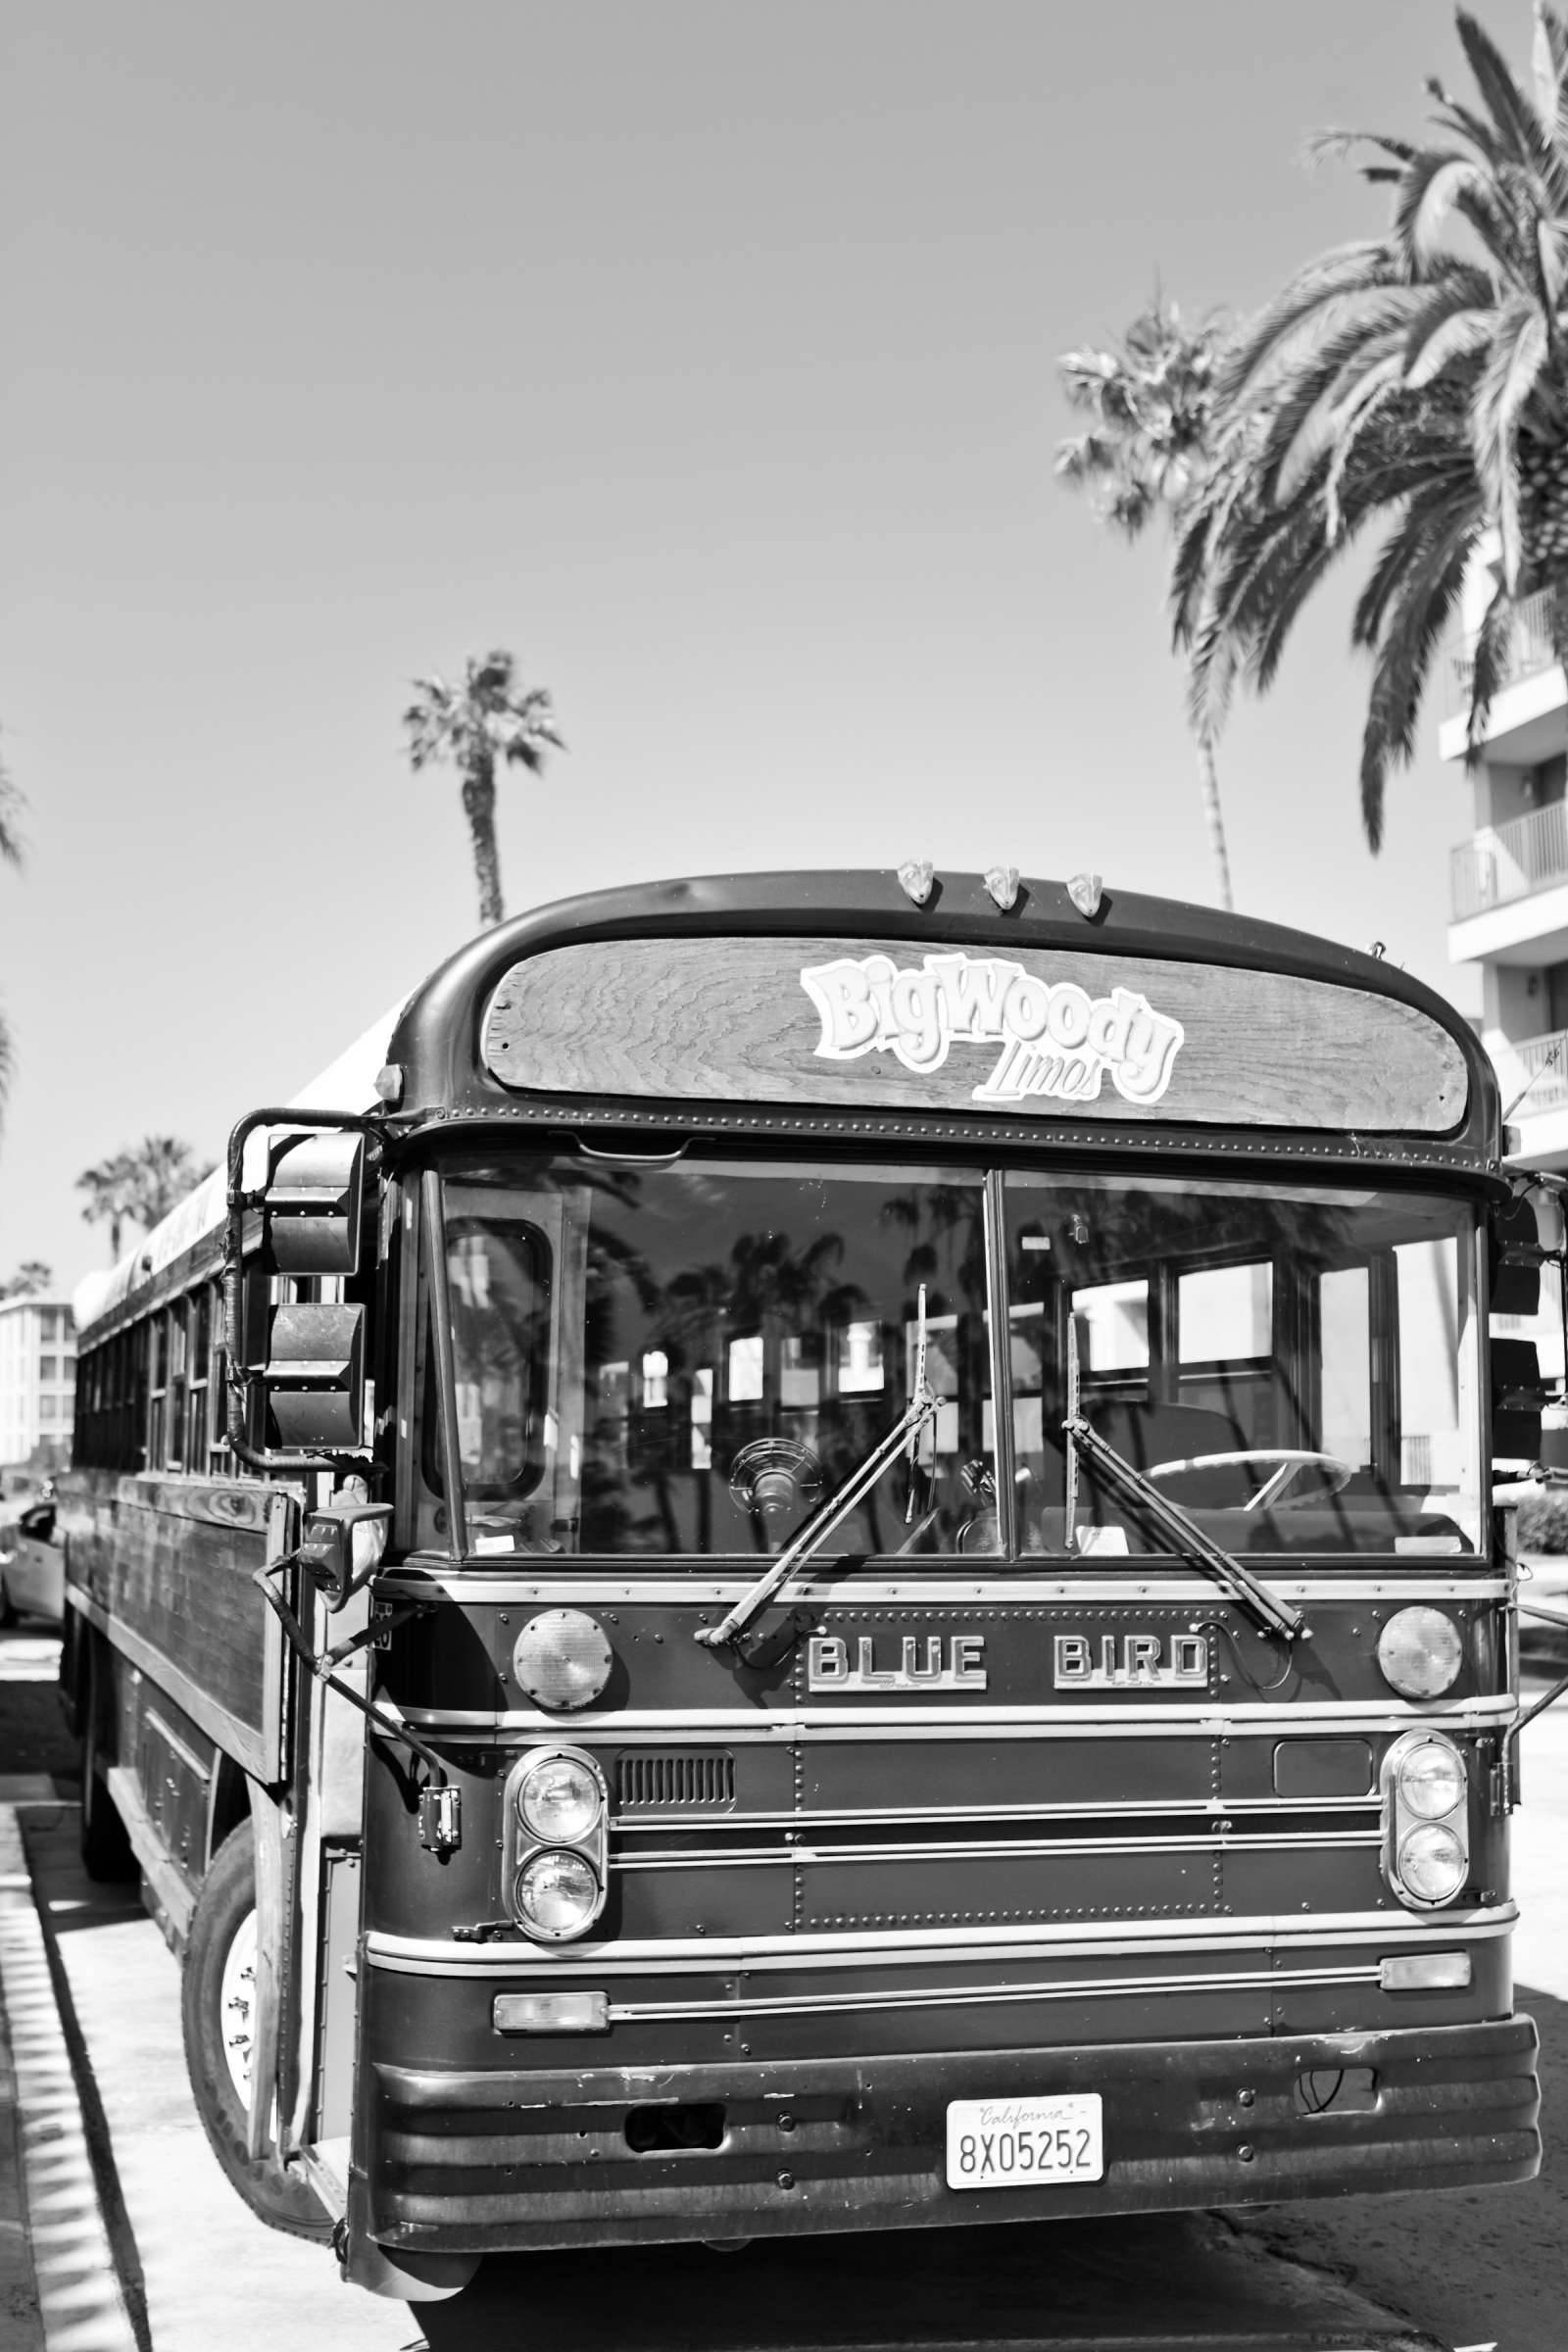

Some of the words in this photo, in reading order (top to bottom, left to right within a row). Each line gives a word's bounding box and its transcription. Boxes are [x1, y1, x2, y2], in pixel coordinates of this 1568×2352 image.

[983, 1040, 1102, 1097] Limos
[808, 1635, 987, 1685] BLUE
[1054, 1634, 1208, 1682] BIRD
[980, 2105, 1074, 2130] California
[959, 2128, 1092, 2174] 8X05252
